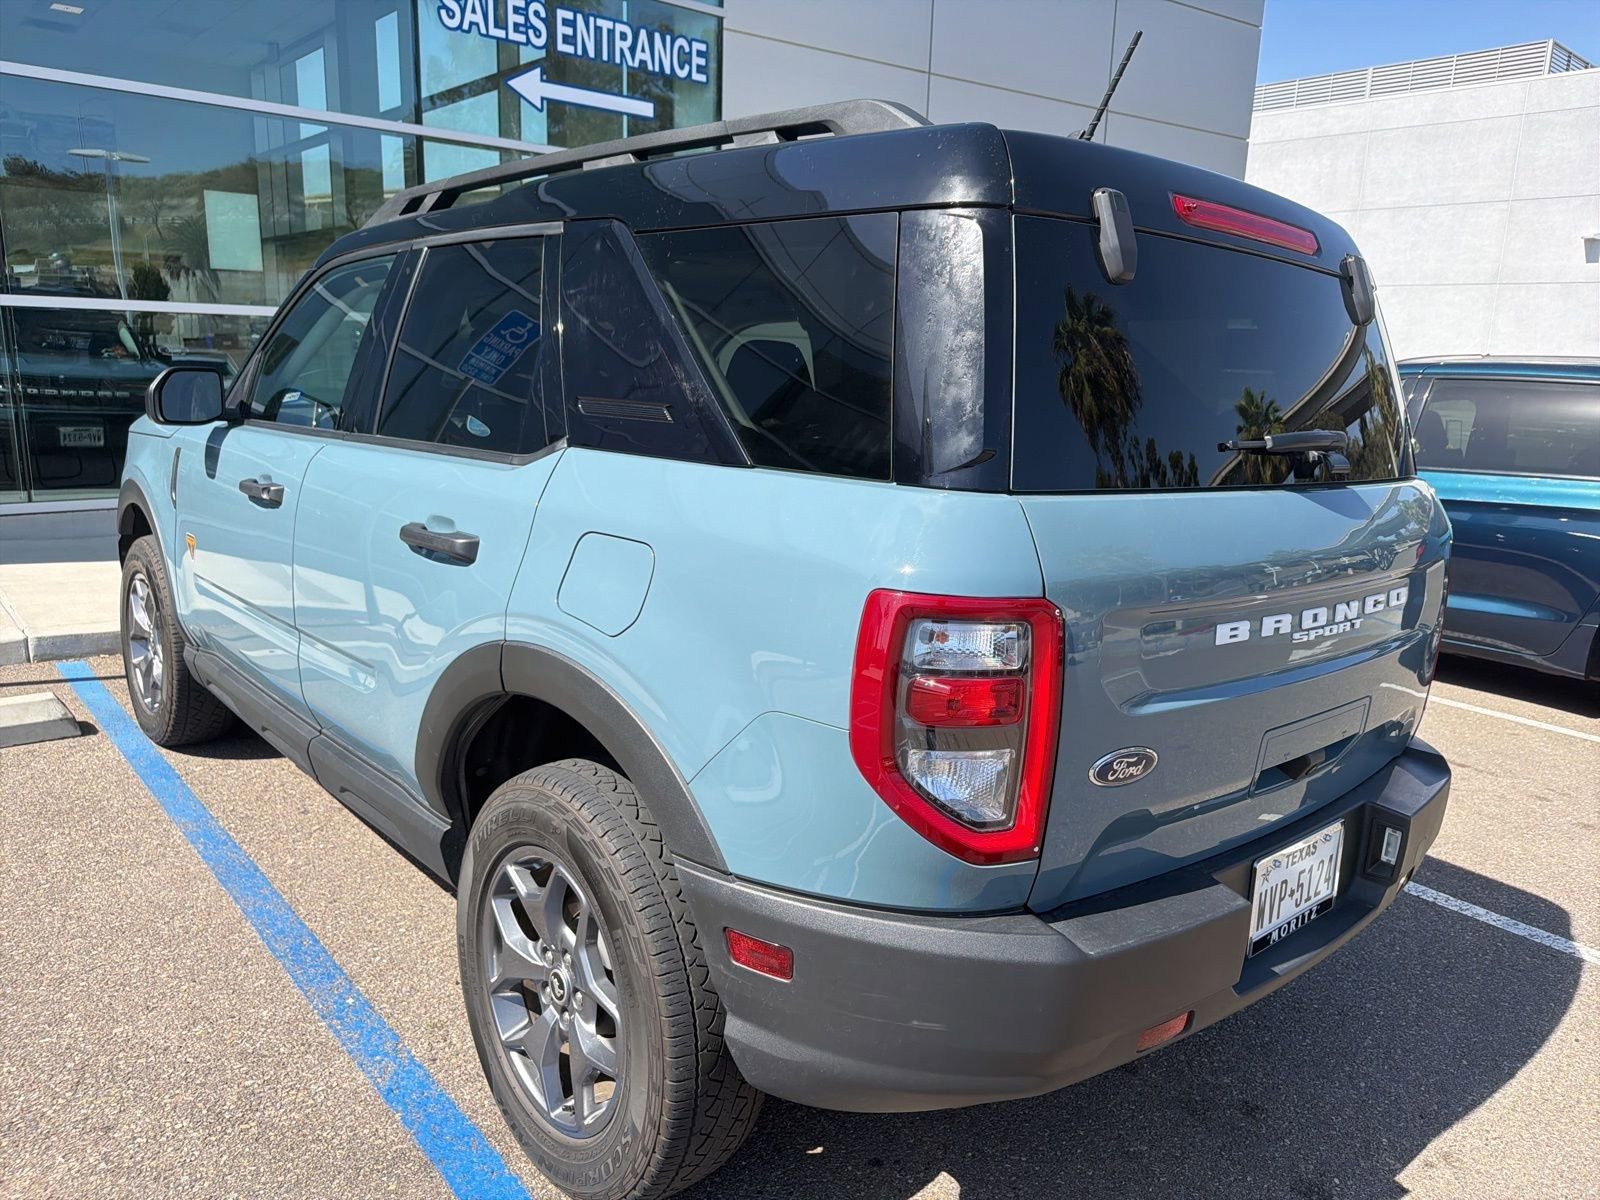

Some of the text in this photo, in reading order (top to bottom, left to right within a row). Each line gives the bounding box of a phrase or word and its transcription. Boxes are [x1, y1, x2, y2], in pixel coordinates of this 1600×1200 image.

[438, 0, 709, 84] SALES ENTRANCE
[1215, 586, 1408, 646] BRONCO
[1292, 618, 1364, 643] SPORT
[1107, 756, 1146, 781] Ford
[1285, 841, 1319, 869] TEXAS
[1270, 905, 1319, 945] MORITZ
